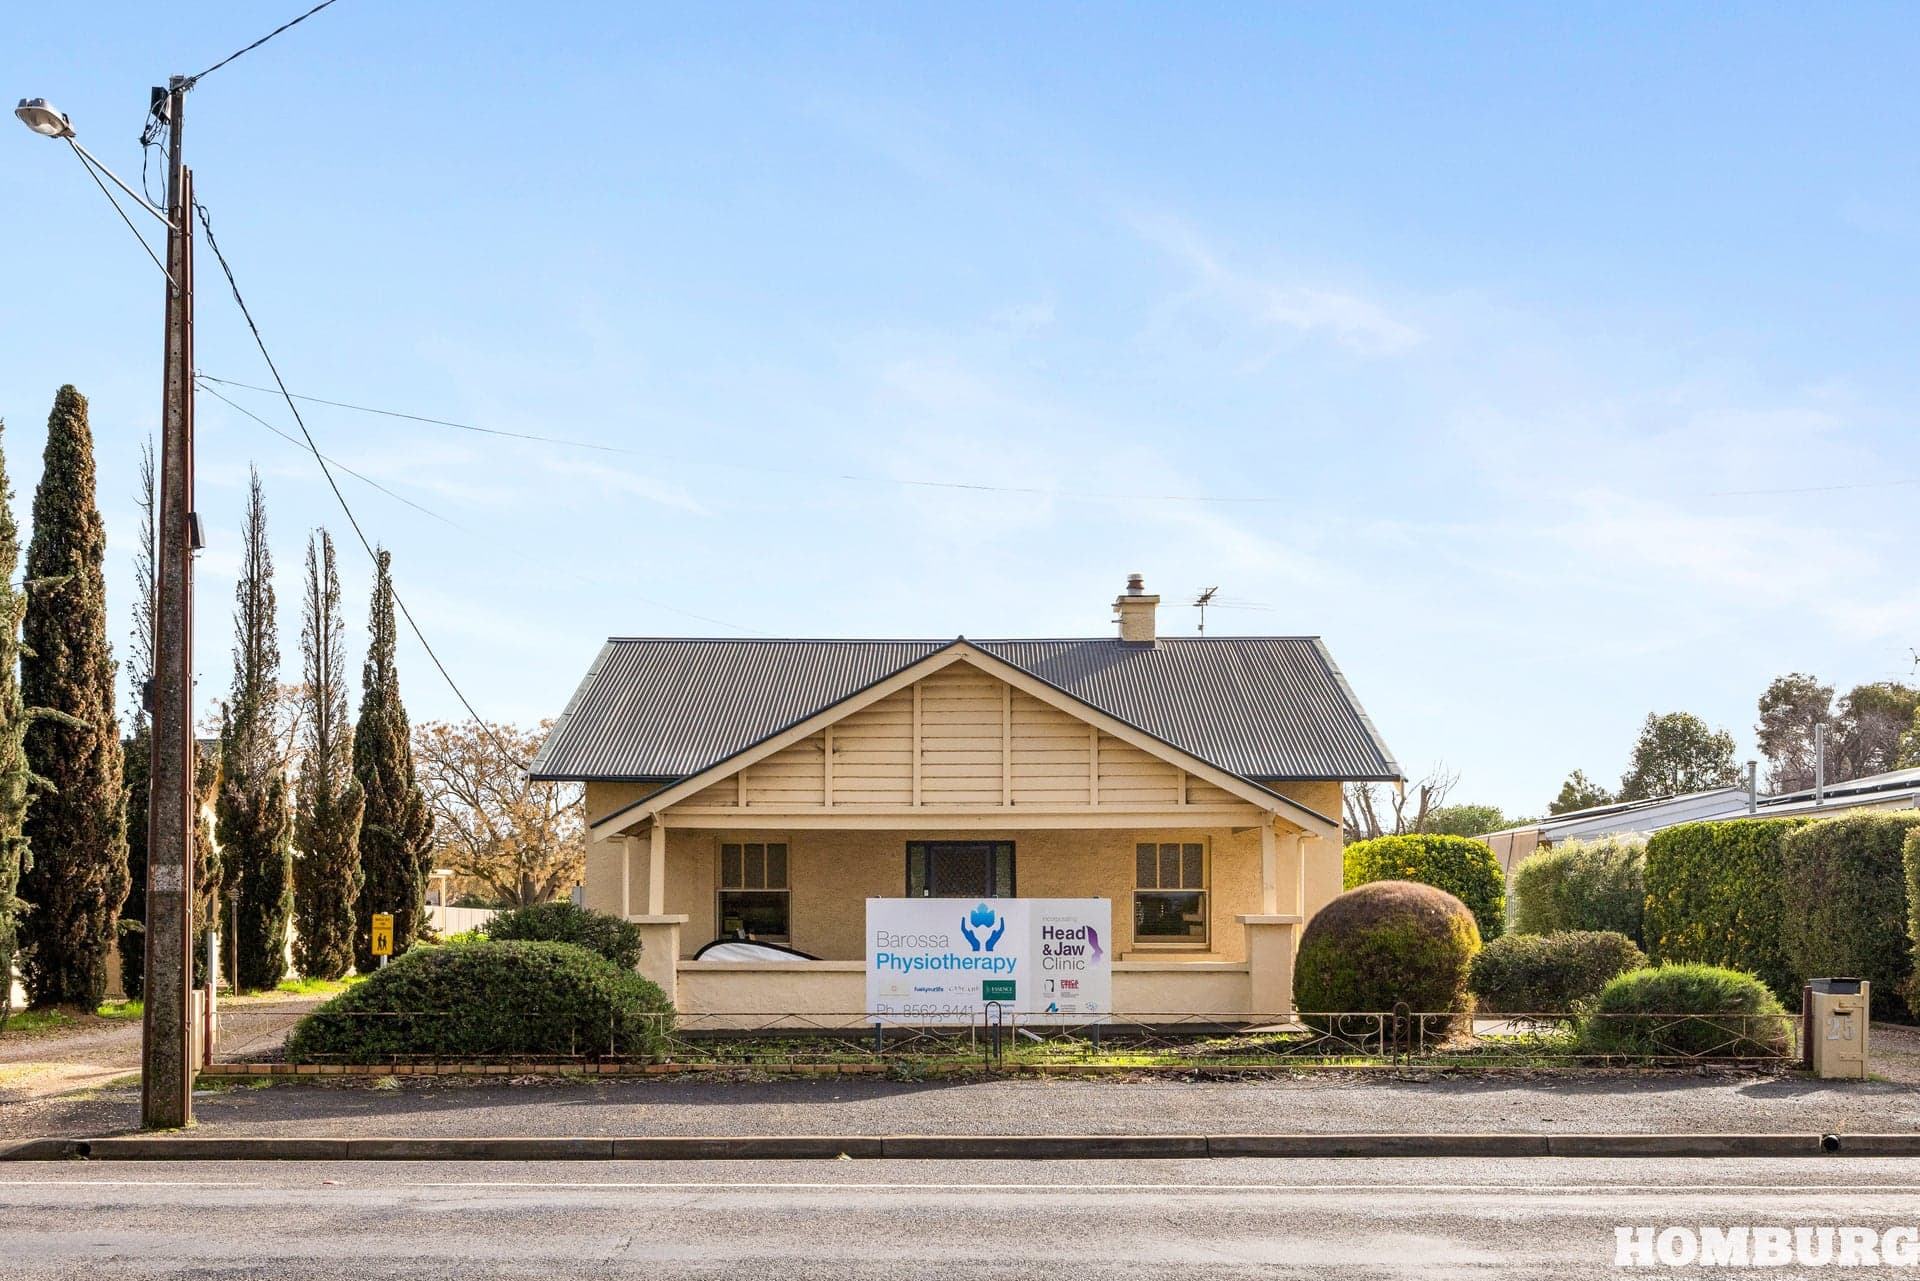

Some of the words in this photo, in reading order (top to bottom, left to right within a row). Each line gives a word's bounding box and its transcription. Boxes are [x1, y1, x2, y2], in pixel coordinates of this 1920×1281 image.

[877, 930, 949, 948] Barossa
[1042, 925, 1086, 940] Head
[1042, 943, 1052, 956] &
[1054, 941, 1085, 956] Jaw
[876, 953, 1017, 974] Physiotherapy
[1042, 956, 1085, 971] Clinic
[903, 1004, 937, 1018] 8562
[942, 1004, 974, 1018] 3441
[1826, 1016, 1857, 1041] 25
